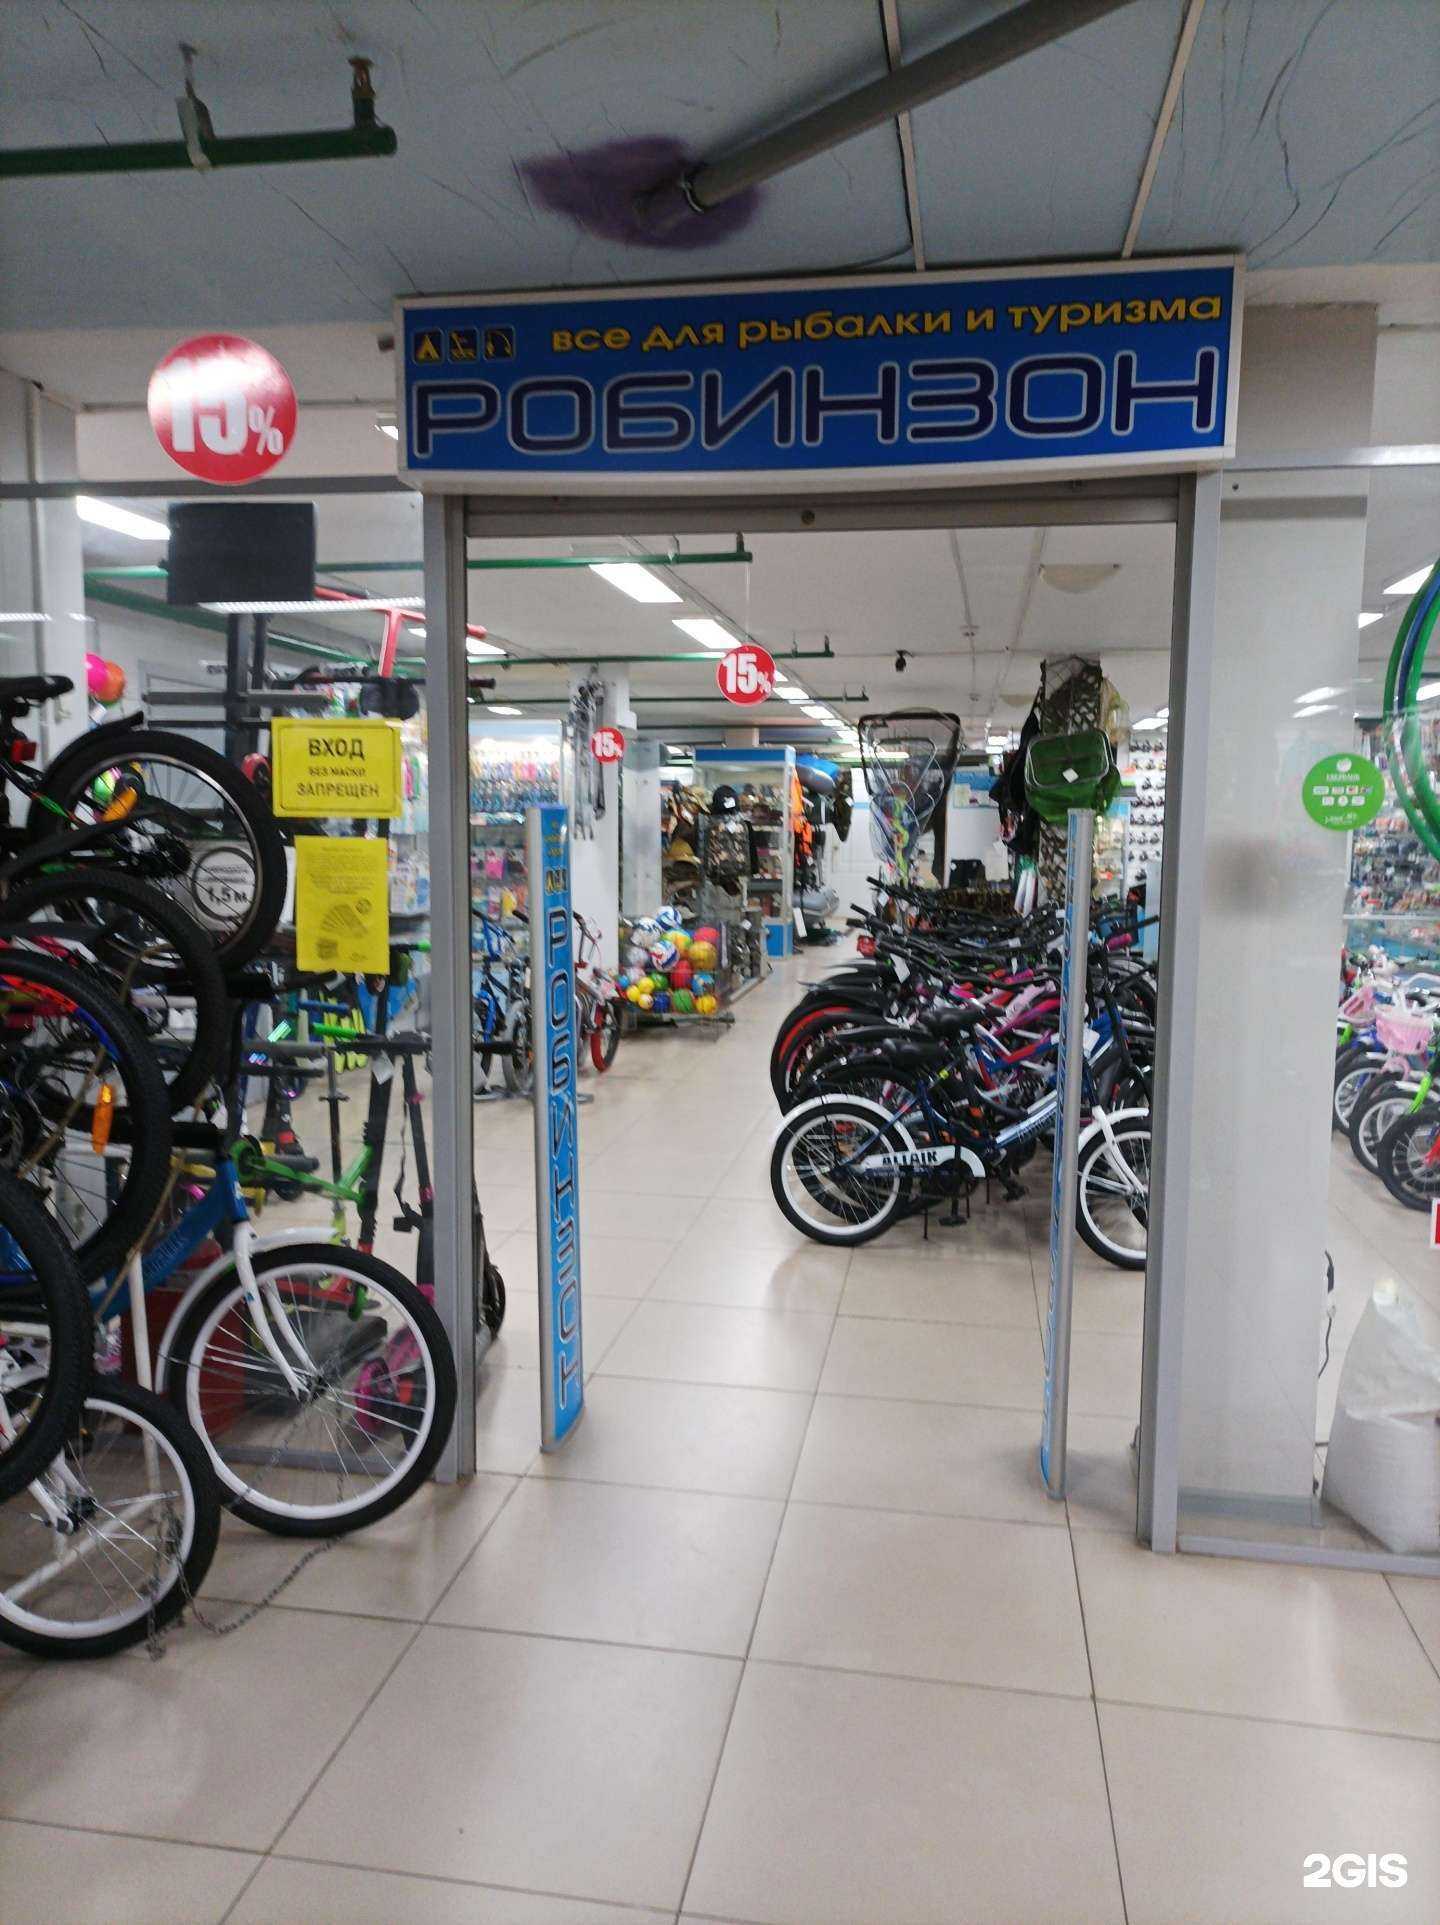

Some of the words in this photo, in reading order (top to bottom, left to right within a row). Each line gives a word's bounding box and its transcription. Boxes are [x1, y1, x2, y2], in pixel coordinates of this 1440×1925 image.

[551, 326, 631, 352] все
[642, 318, 725, 352] для
[738, 310, 951, 349] рыбалки
[966, 307, 995, 331] и
[1008, 295, 1222, 334] туризма
[412, 346, 1221, 458] РОБИНЗОН
[722, 652, 772, 695] 15%
[308, 738, 365, 760] ВХОД
[296, 782, 380, 798] ЗАПРЕЩЕН
